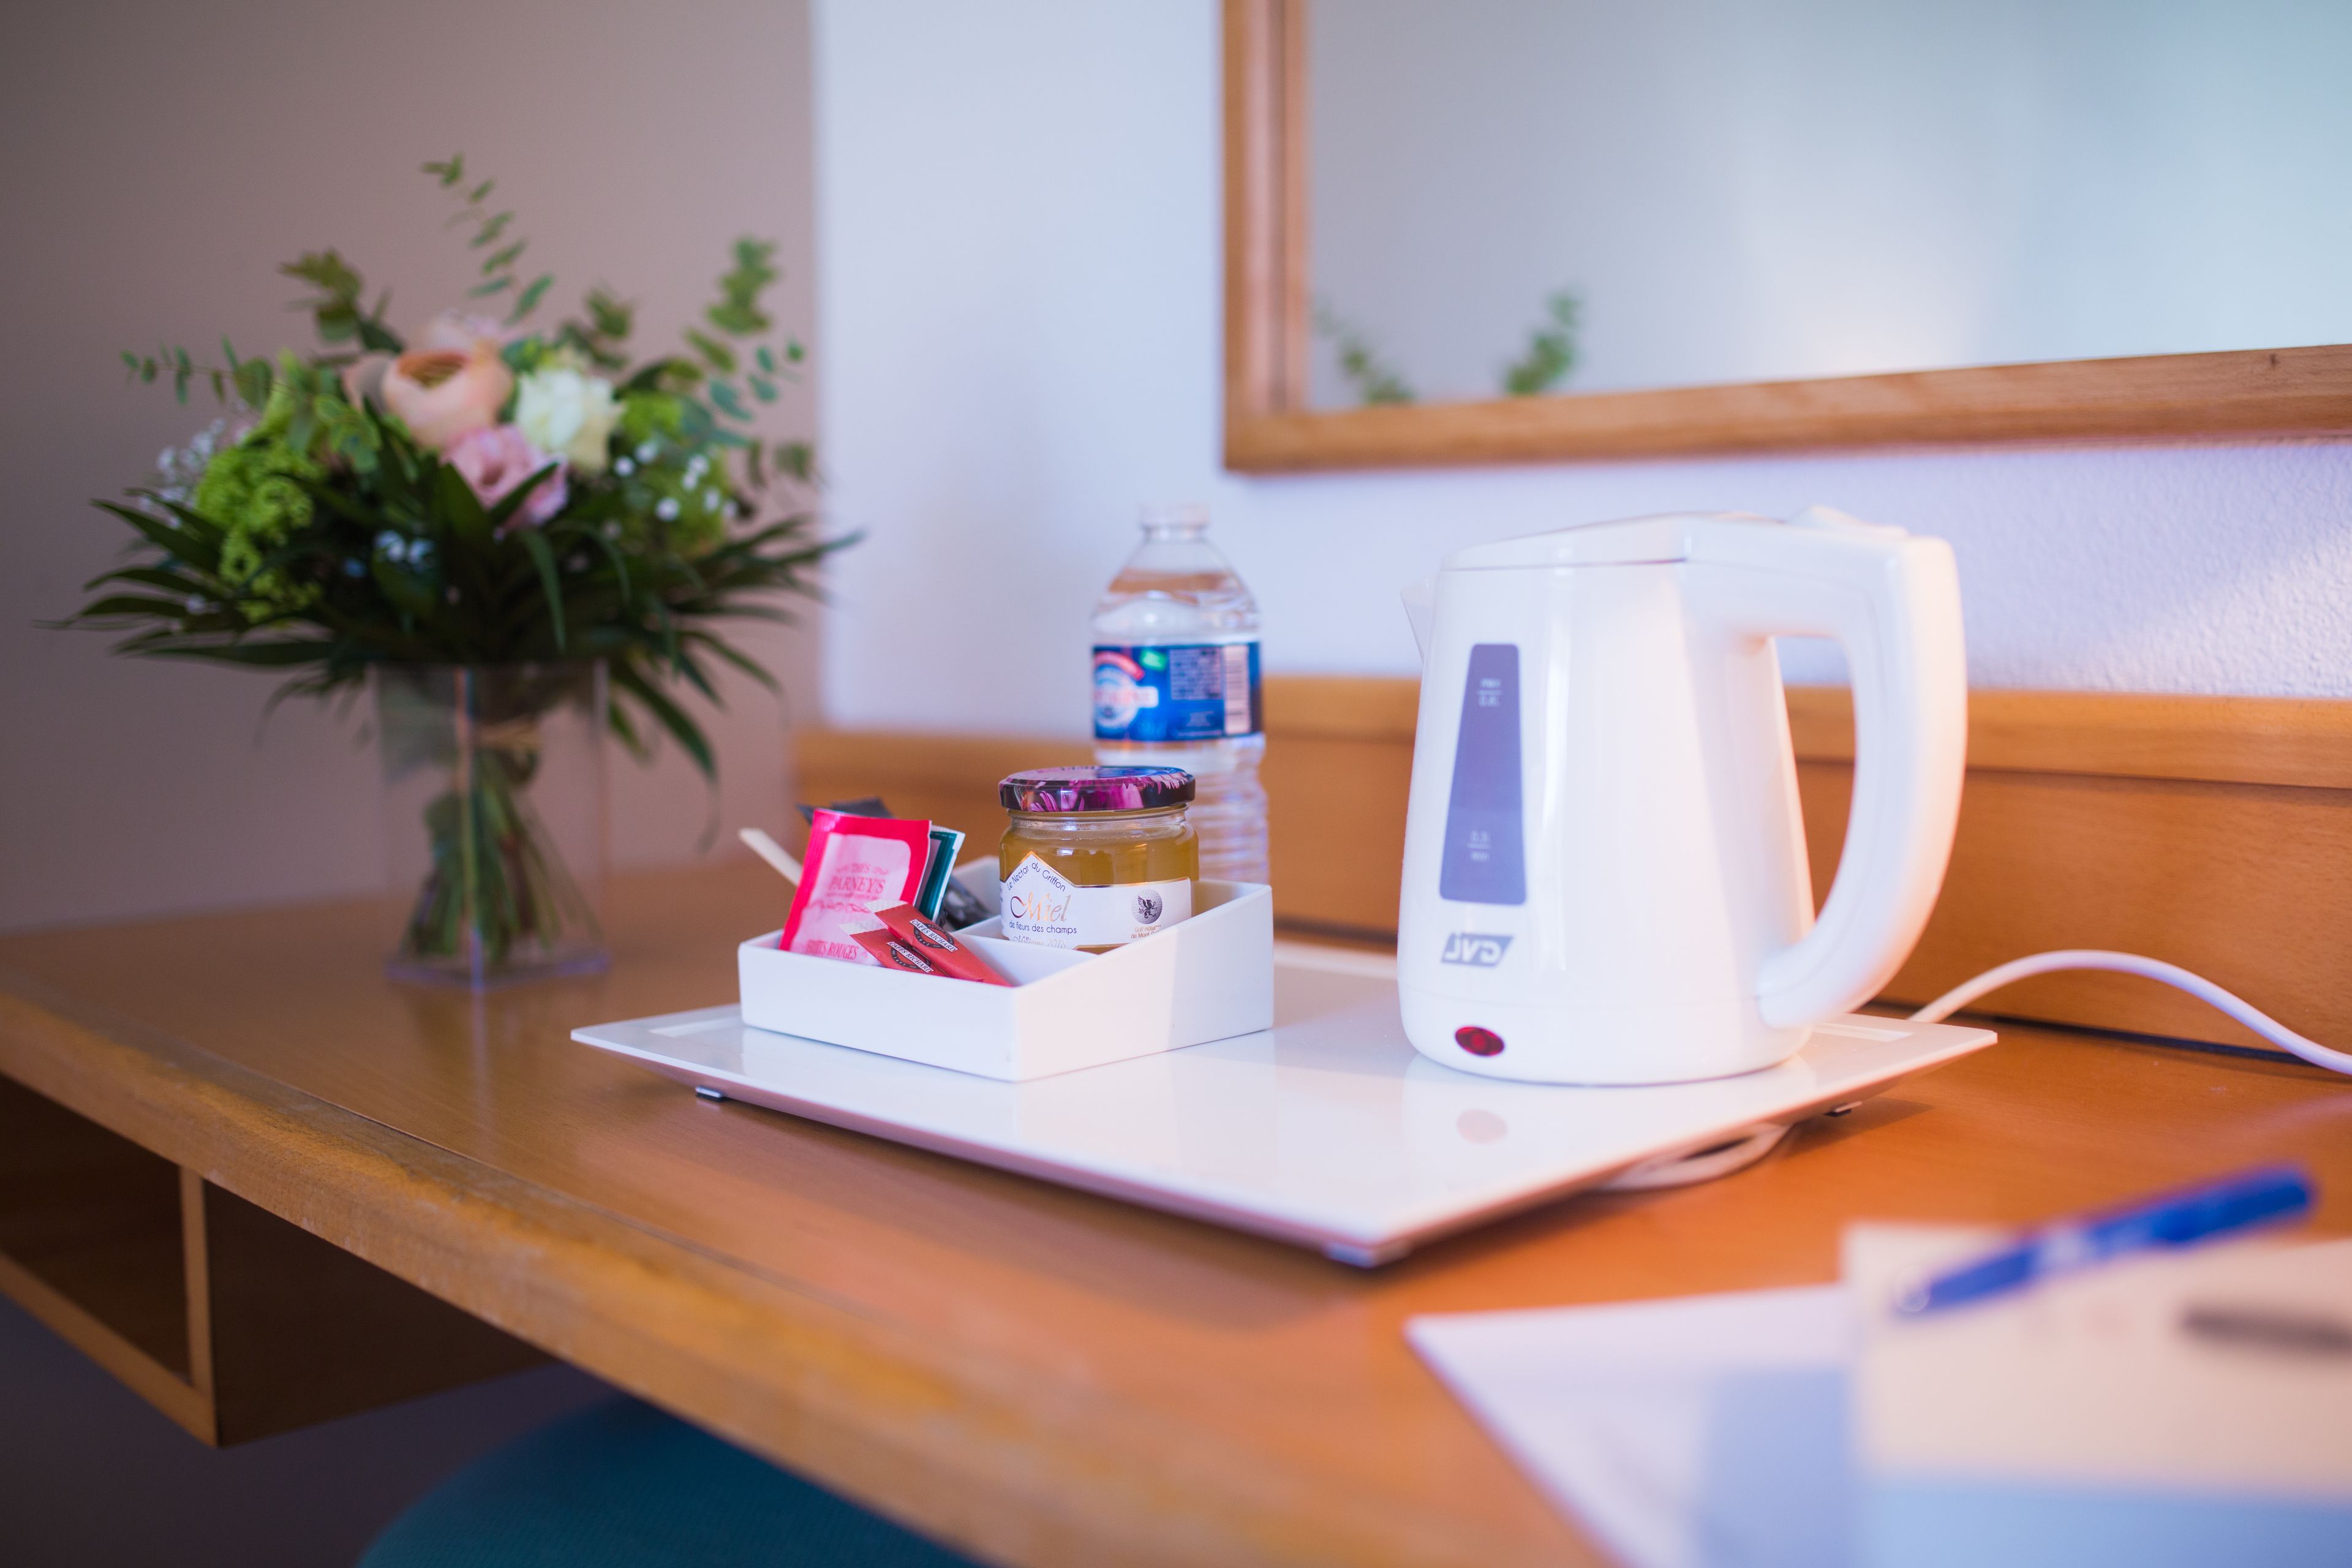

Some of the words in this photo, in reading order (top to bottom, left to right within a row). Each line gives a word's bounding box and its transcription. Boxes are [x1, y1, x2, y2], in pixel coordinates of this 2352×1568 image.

[1007, 882, 1013, 891] Le
[1012, 865, 1029, 884] Nectar
[1031, 862, 1041, 872] du
[1042, 870, 1066, 891] Griffon
[1011, 891, 1071, 922] Miel
[1009, 919, 1015, 929] de
[1032, 924, 1044, 932] des
[1046, 924, 1077, 935] champs
[827, 941, 859, 960] ROUGES
[929, 933, 956, 951] RICHARD
